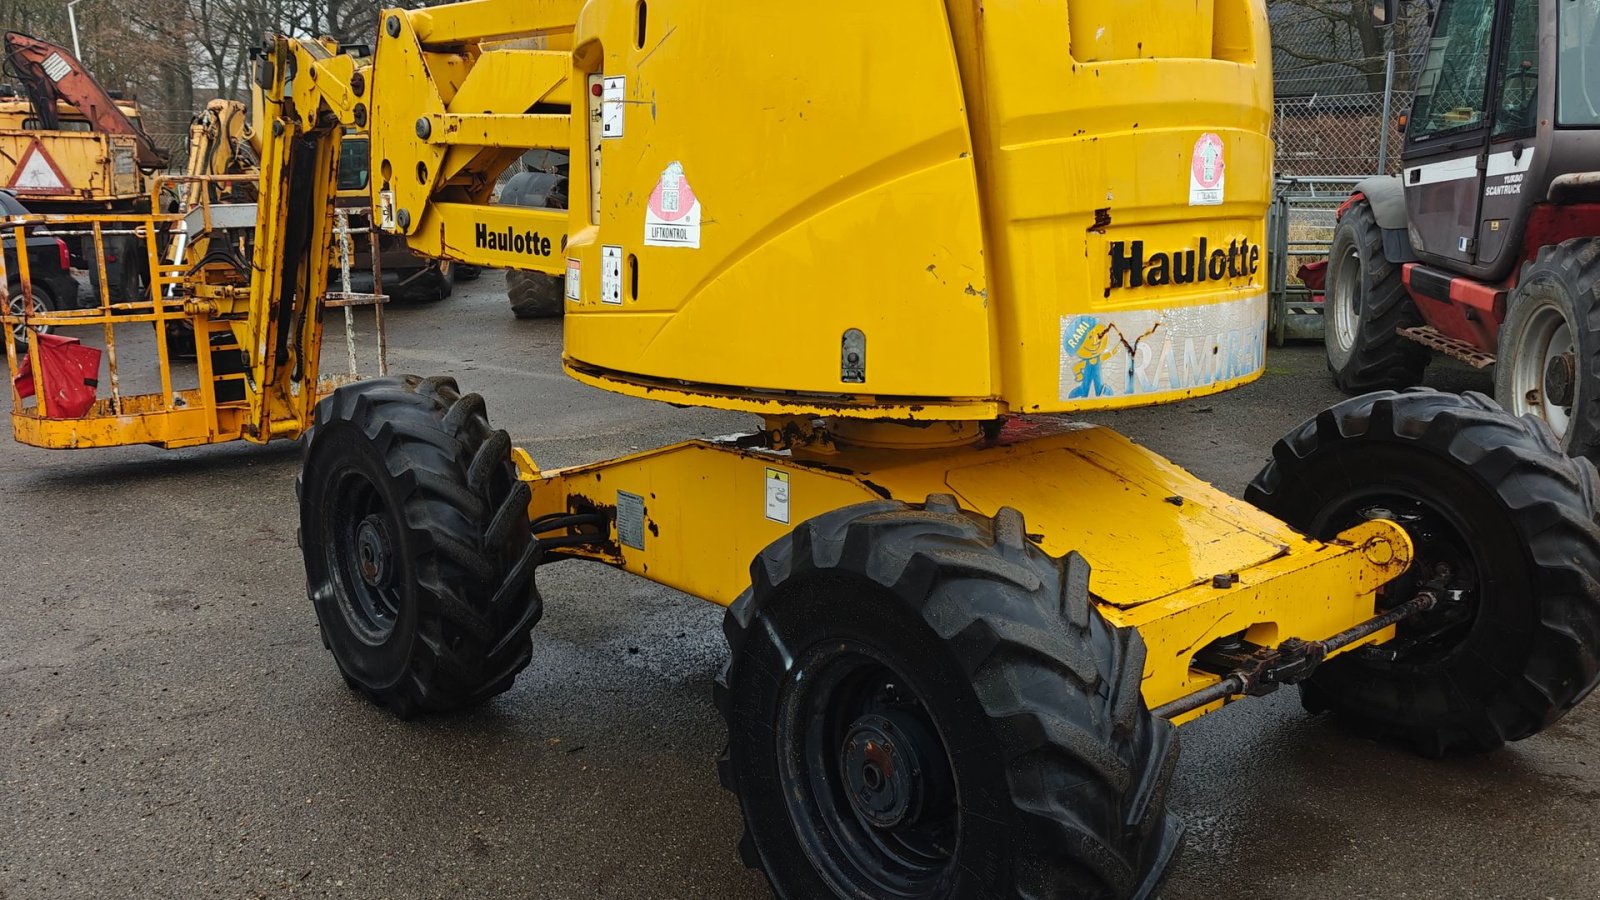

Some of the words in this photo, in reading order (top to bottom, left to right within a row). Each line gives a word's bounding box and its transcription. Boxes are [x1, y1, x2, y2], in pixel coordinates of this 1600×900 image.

[1504, 174, 1523, 184] TURBO
[1485, 184, 1521, 196] SCANTRUCK
[475, 223, 551, 257] Haulotte
[651, 226, 688, 240] LIFTKONTROL
[1110, 237, 1258, 289] Haulotte
[1067, 320, 1090, 349] RAMI
